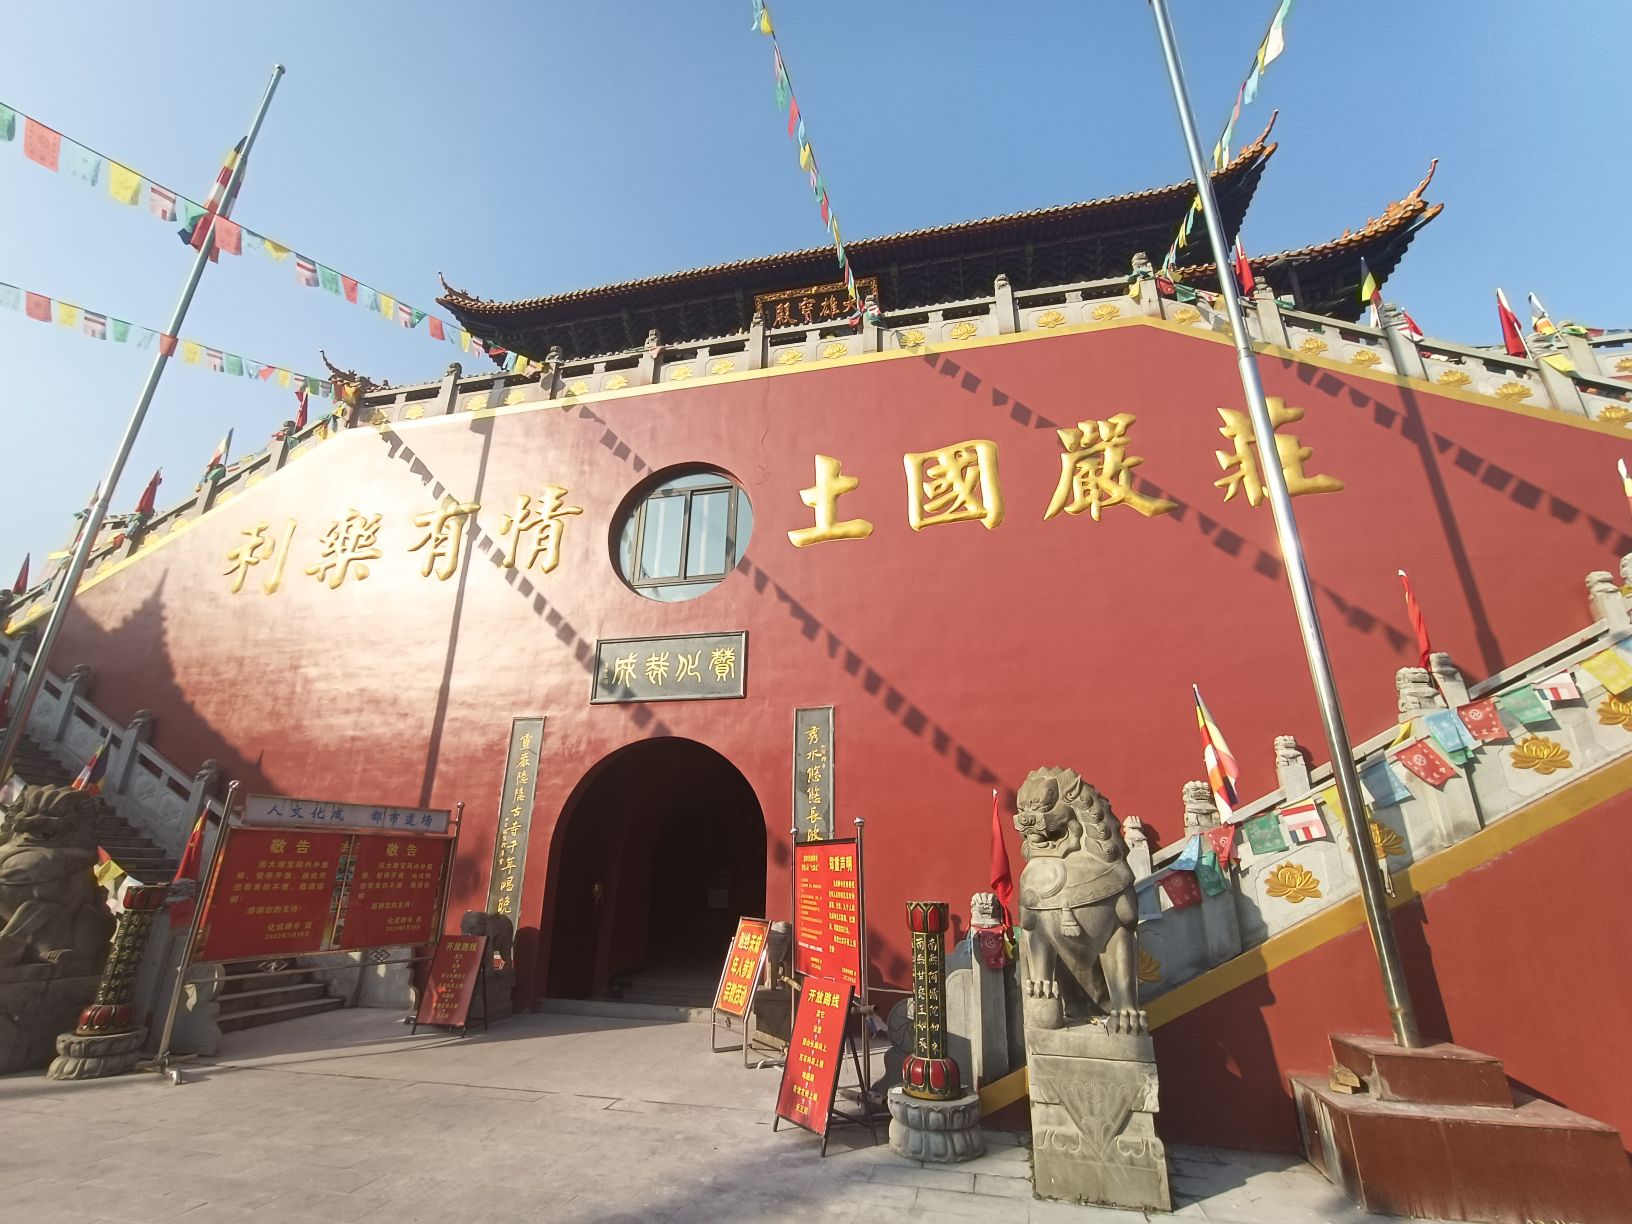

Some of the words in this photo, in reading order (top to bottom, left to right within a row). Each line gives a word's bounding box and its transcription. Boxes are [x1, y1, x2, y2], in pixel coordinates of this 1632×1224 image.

[267, 804, 345, 822] 人文化成
[808, 988, 840, 1008] 开放路线
